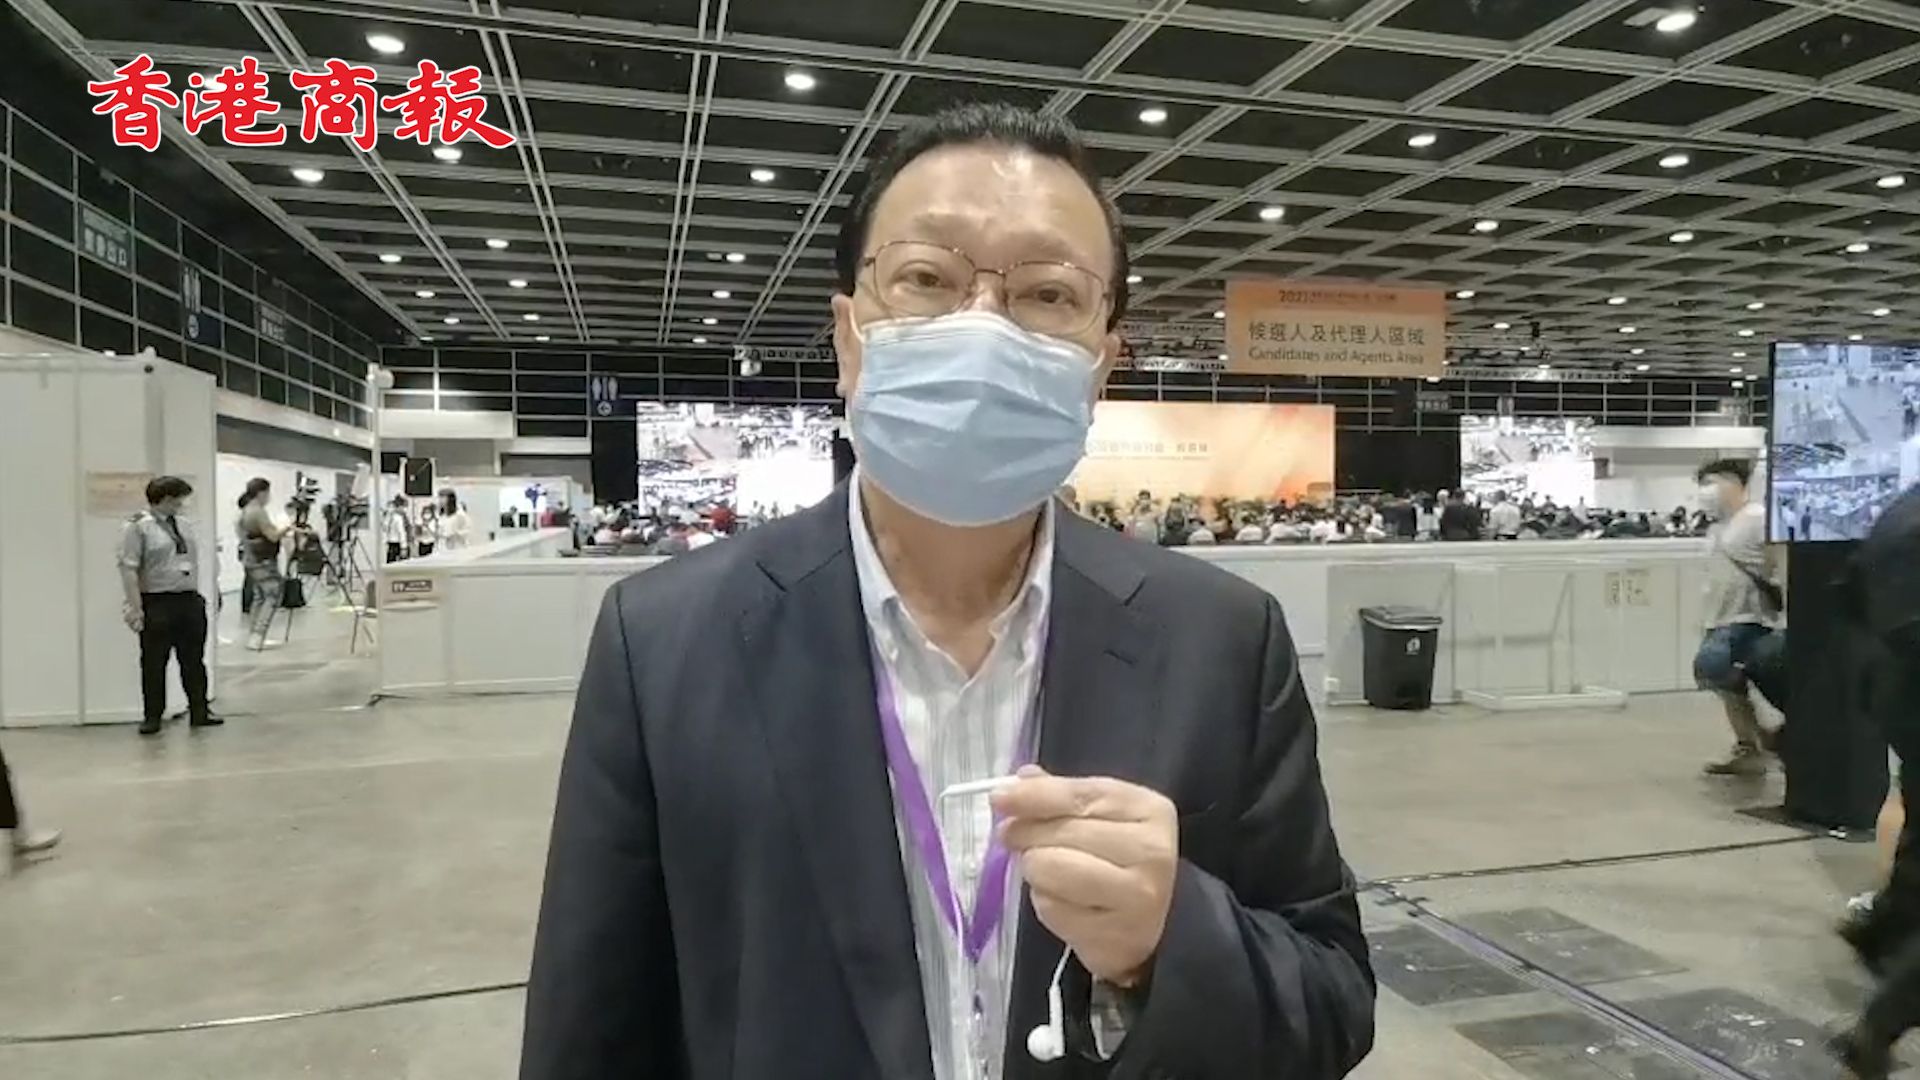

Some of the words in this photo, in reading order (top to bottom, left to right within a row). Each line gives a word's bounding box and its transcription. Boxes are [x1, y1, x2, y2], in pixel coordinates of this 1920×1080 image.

[1248, 321, 1426, 346] 候選人及代理人區域
[1248, 346, 1320, 362] Candidates
[1324, 349, 1348, 362] and
[1352, 350, 1393, 365] Agents
[1397, 352, 1425, 365] Area
